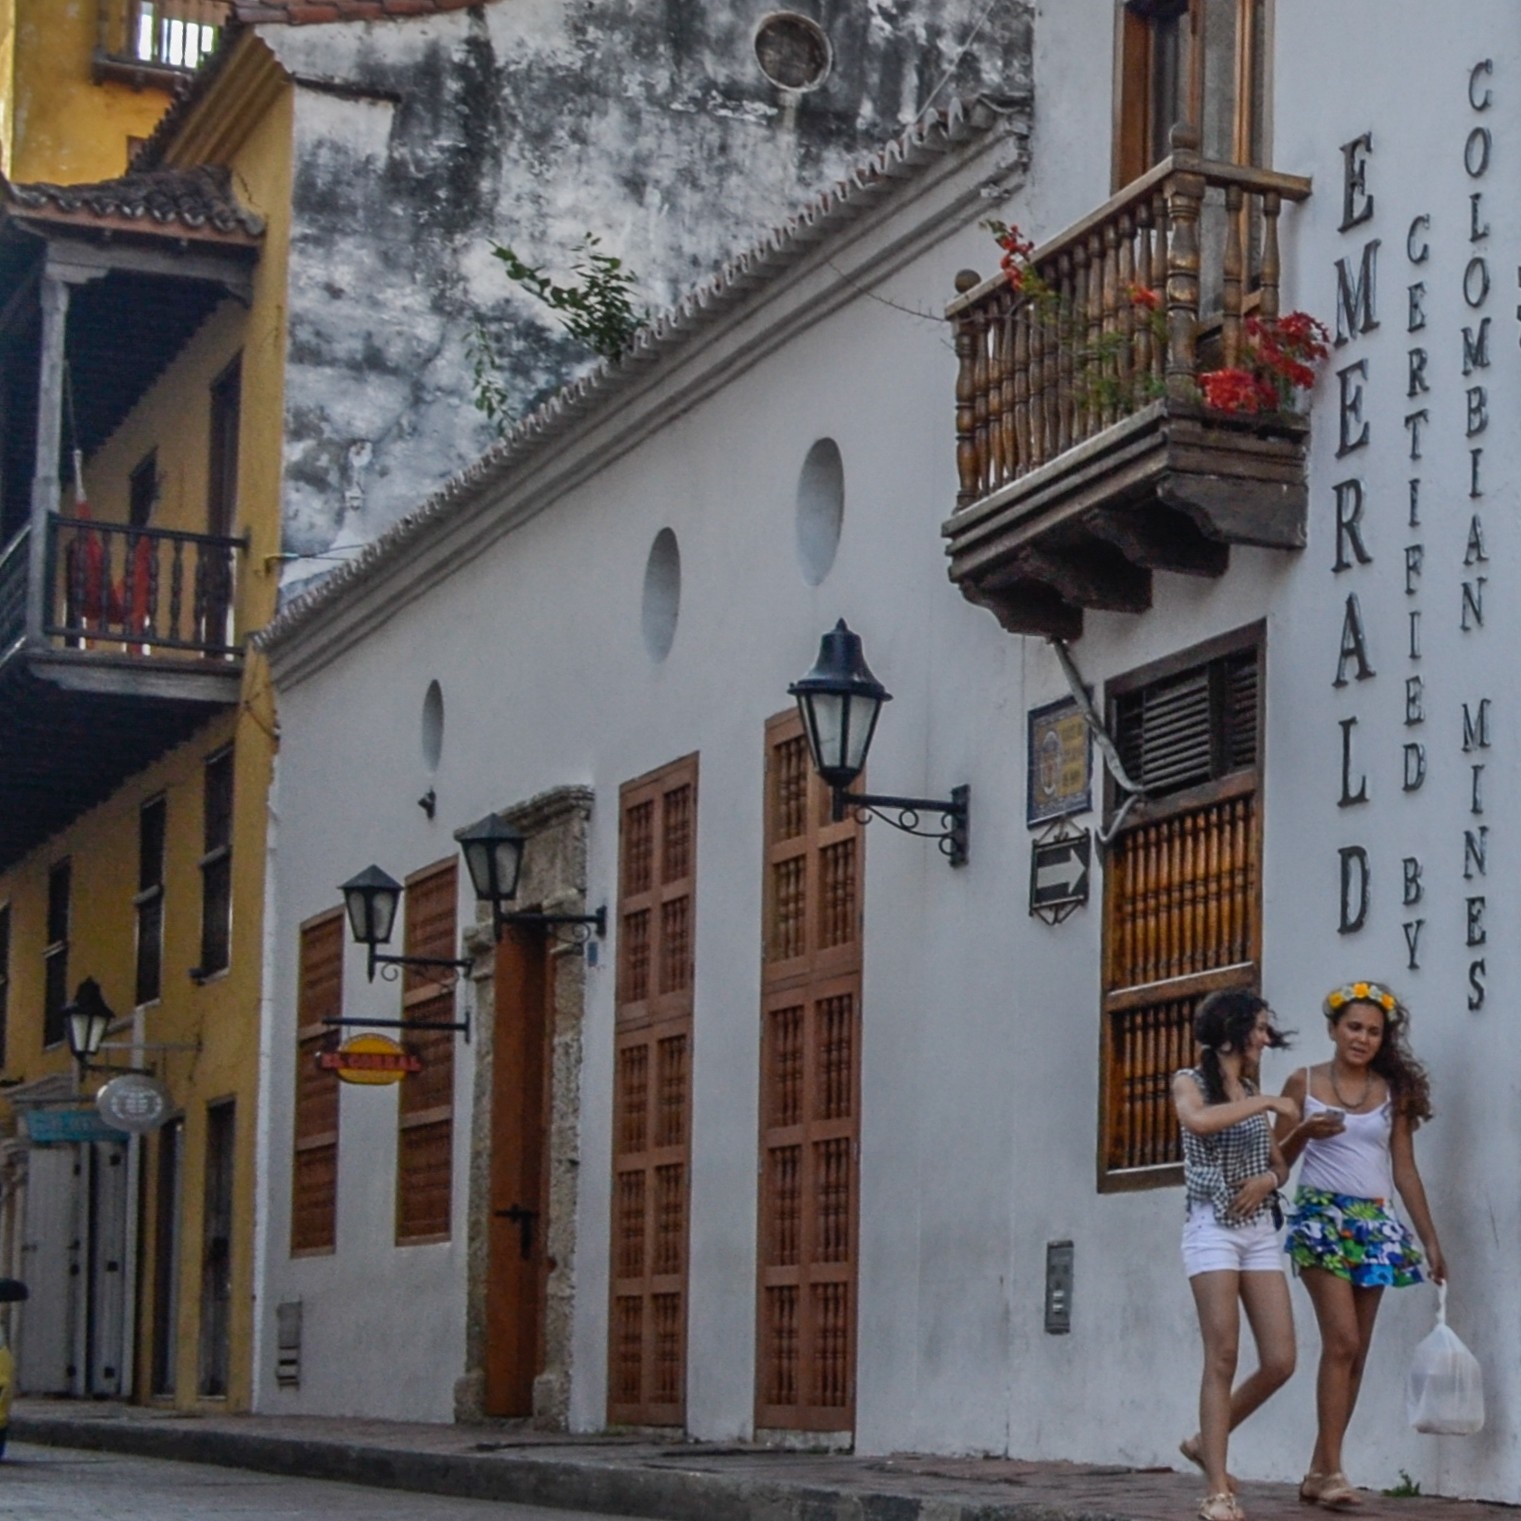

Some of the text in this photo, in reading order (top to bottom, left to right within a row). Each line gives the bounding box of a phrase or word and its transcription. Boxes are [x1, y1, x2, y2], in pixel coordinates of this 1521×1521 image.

[1330, 130, 1382, 936] EMERALD
[1402, 213, 1431, 970] CERTIFIED BY
[1460, 57, 1493, 1012] COLOMBIAN MINES
